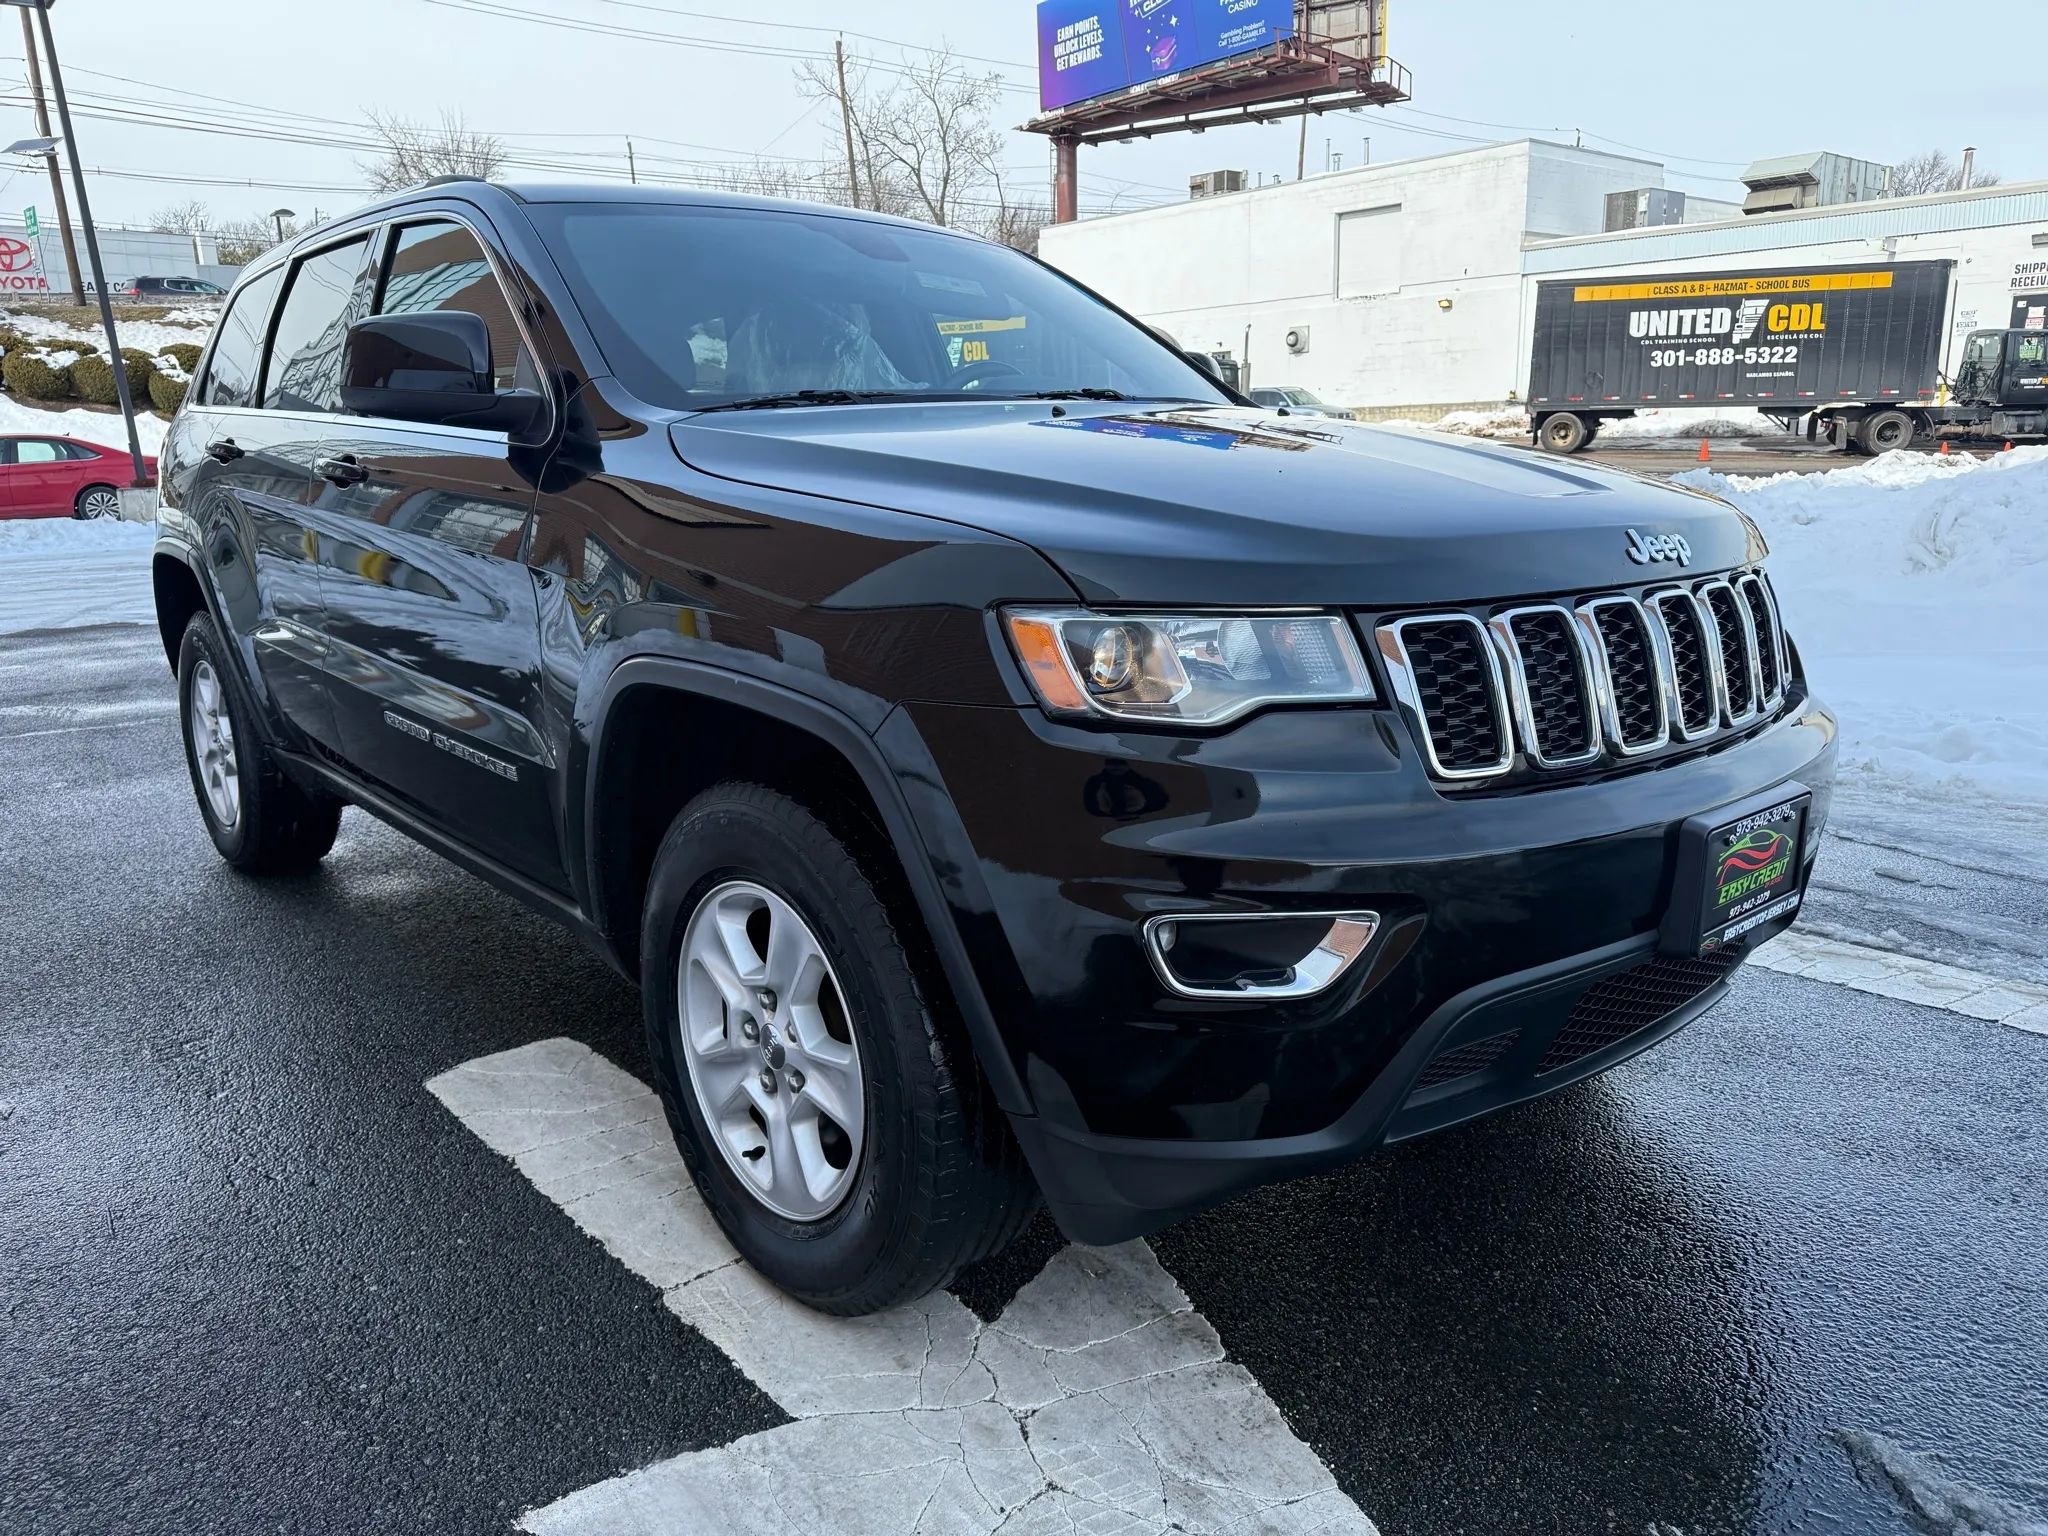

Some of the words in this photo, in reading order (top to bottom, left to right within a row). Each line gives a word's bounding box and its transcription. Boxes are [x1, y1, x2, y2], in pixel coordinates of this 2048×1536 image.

[1228, 0, 1258, 14] CASINO
[1054, 37, 1079, 58] UNLOCK
[1079, 28, 1105, 49] LEVELS.
[1057, 23, 1074, 43] EARN
[1074, 15, 1100, 36] POINTS.
[1056, 55, 1069, 72] GET
[1069, 44, 1103, 67] REWARDS.
[1653, 284, 1680, 295] CLASS
[1681, 284, 1688, 294] A
[1689, 283, 1697, 293] &
[1698, 283, 1705, 292] B
[1713, 281, 1749, 292] HAZMAT
[1755, 280, 1790, 290] SCHOOL
[1792, 279, 1810, 289] BUS
[2010, 274, 2048, 288] RECEIV
[1629, 307, 1732, 338] UNITED
[1767, 303, 1826, 333] CDL
[963, 341, 990, 362] CDL
[1650, 346, 1798, 367] 301-888-5322
[1624, 528, 1692, 567] Jeep
[383, 710, 431, 742] GRAND
[432, 732, 518, 782] CHEROKEE
[1735, 803, 1791, 837] 973-942-3279
[1728, 890, 1771, 919] 973-942-3279
